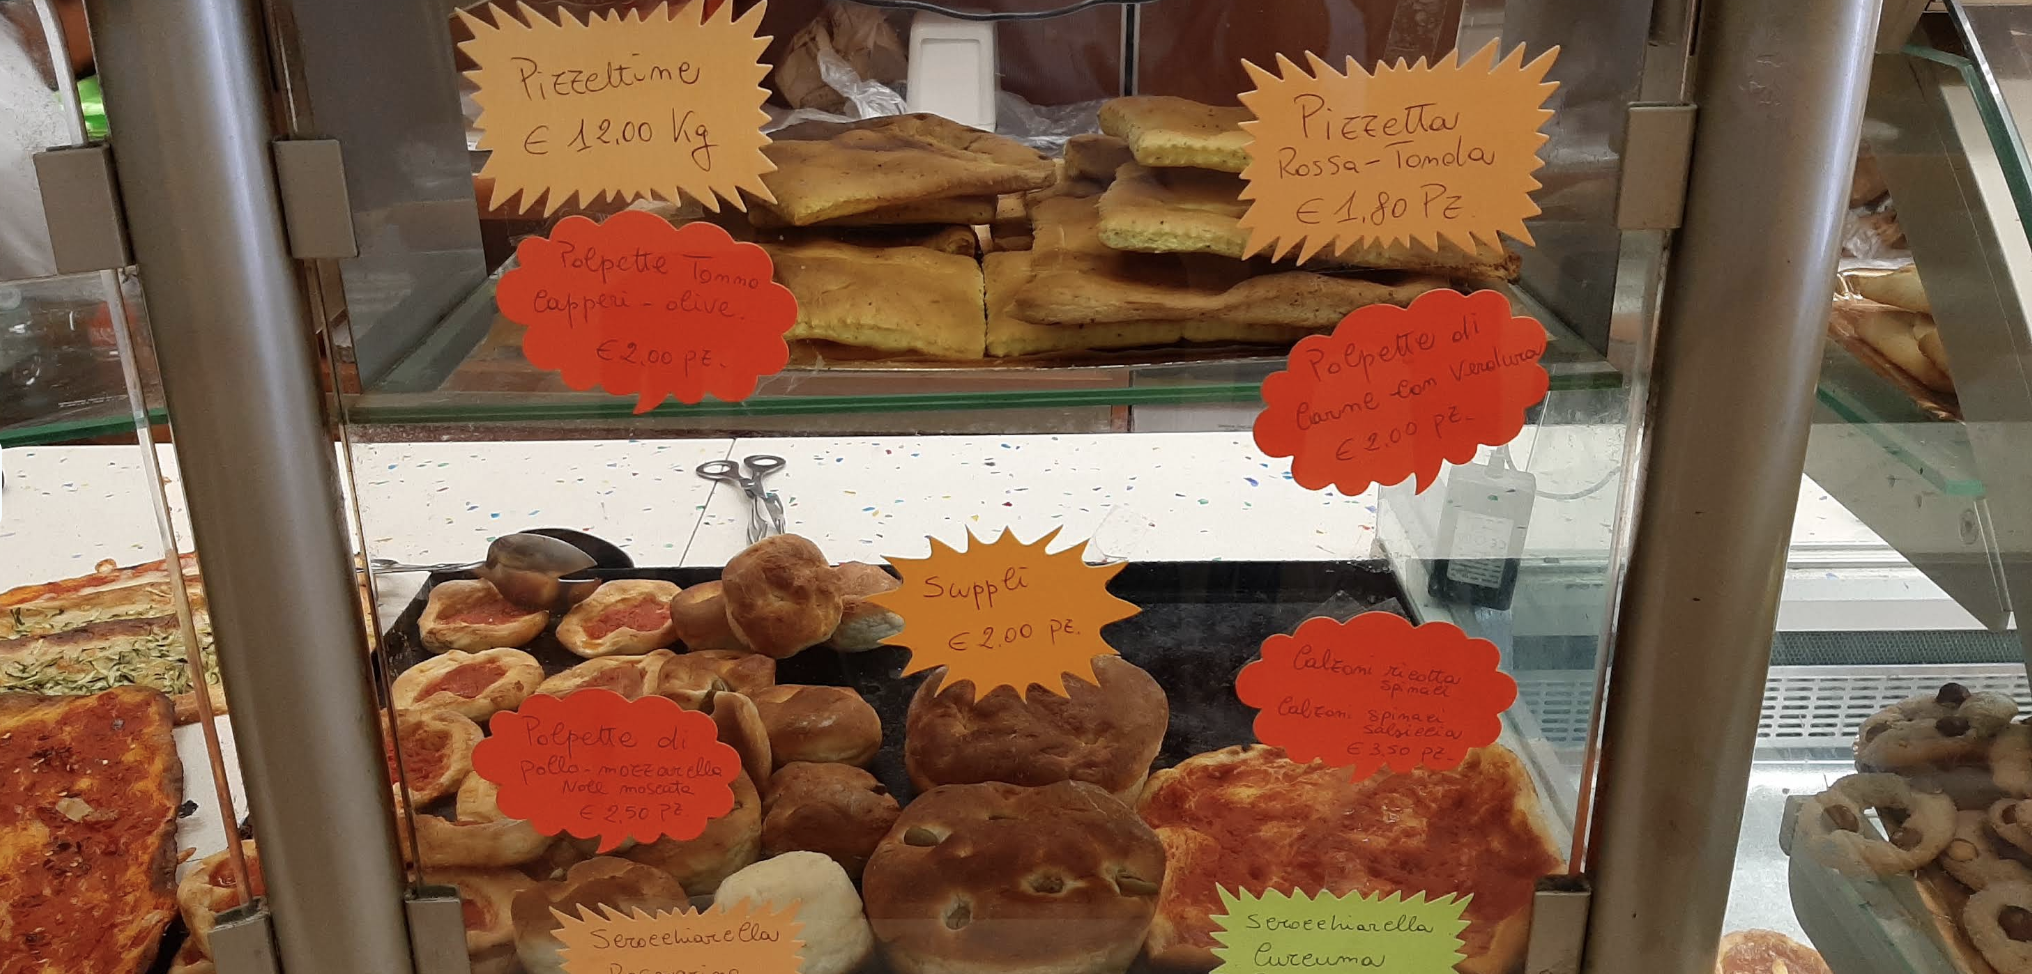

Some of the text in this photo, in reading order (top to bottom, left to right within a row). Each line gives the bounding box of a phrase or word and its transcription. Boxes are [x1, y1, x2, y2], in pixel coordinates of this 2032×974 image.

[1293, 93, 1459, 140] Pizzetta
[524, 125, 549, 155] €
[671, 107, 718, 172] Kg
[1296, 198, 1324, 224] €
[558, 240, 669, 284] Polpette
[1306, 313, 1480, 382] Polpette di
[948, 632, 970, 651] €
[522, 715, 686, 759] Polpette di
[580, 804, 594, 822] €
